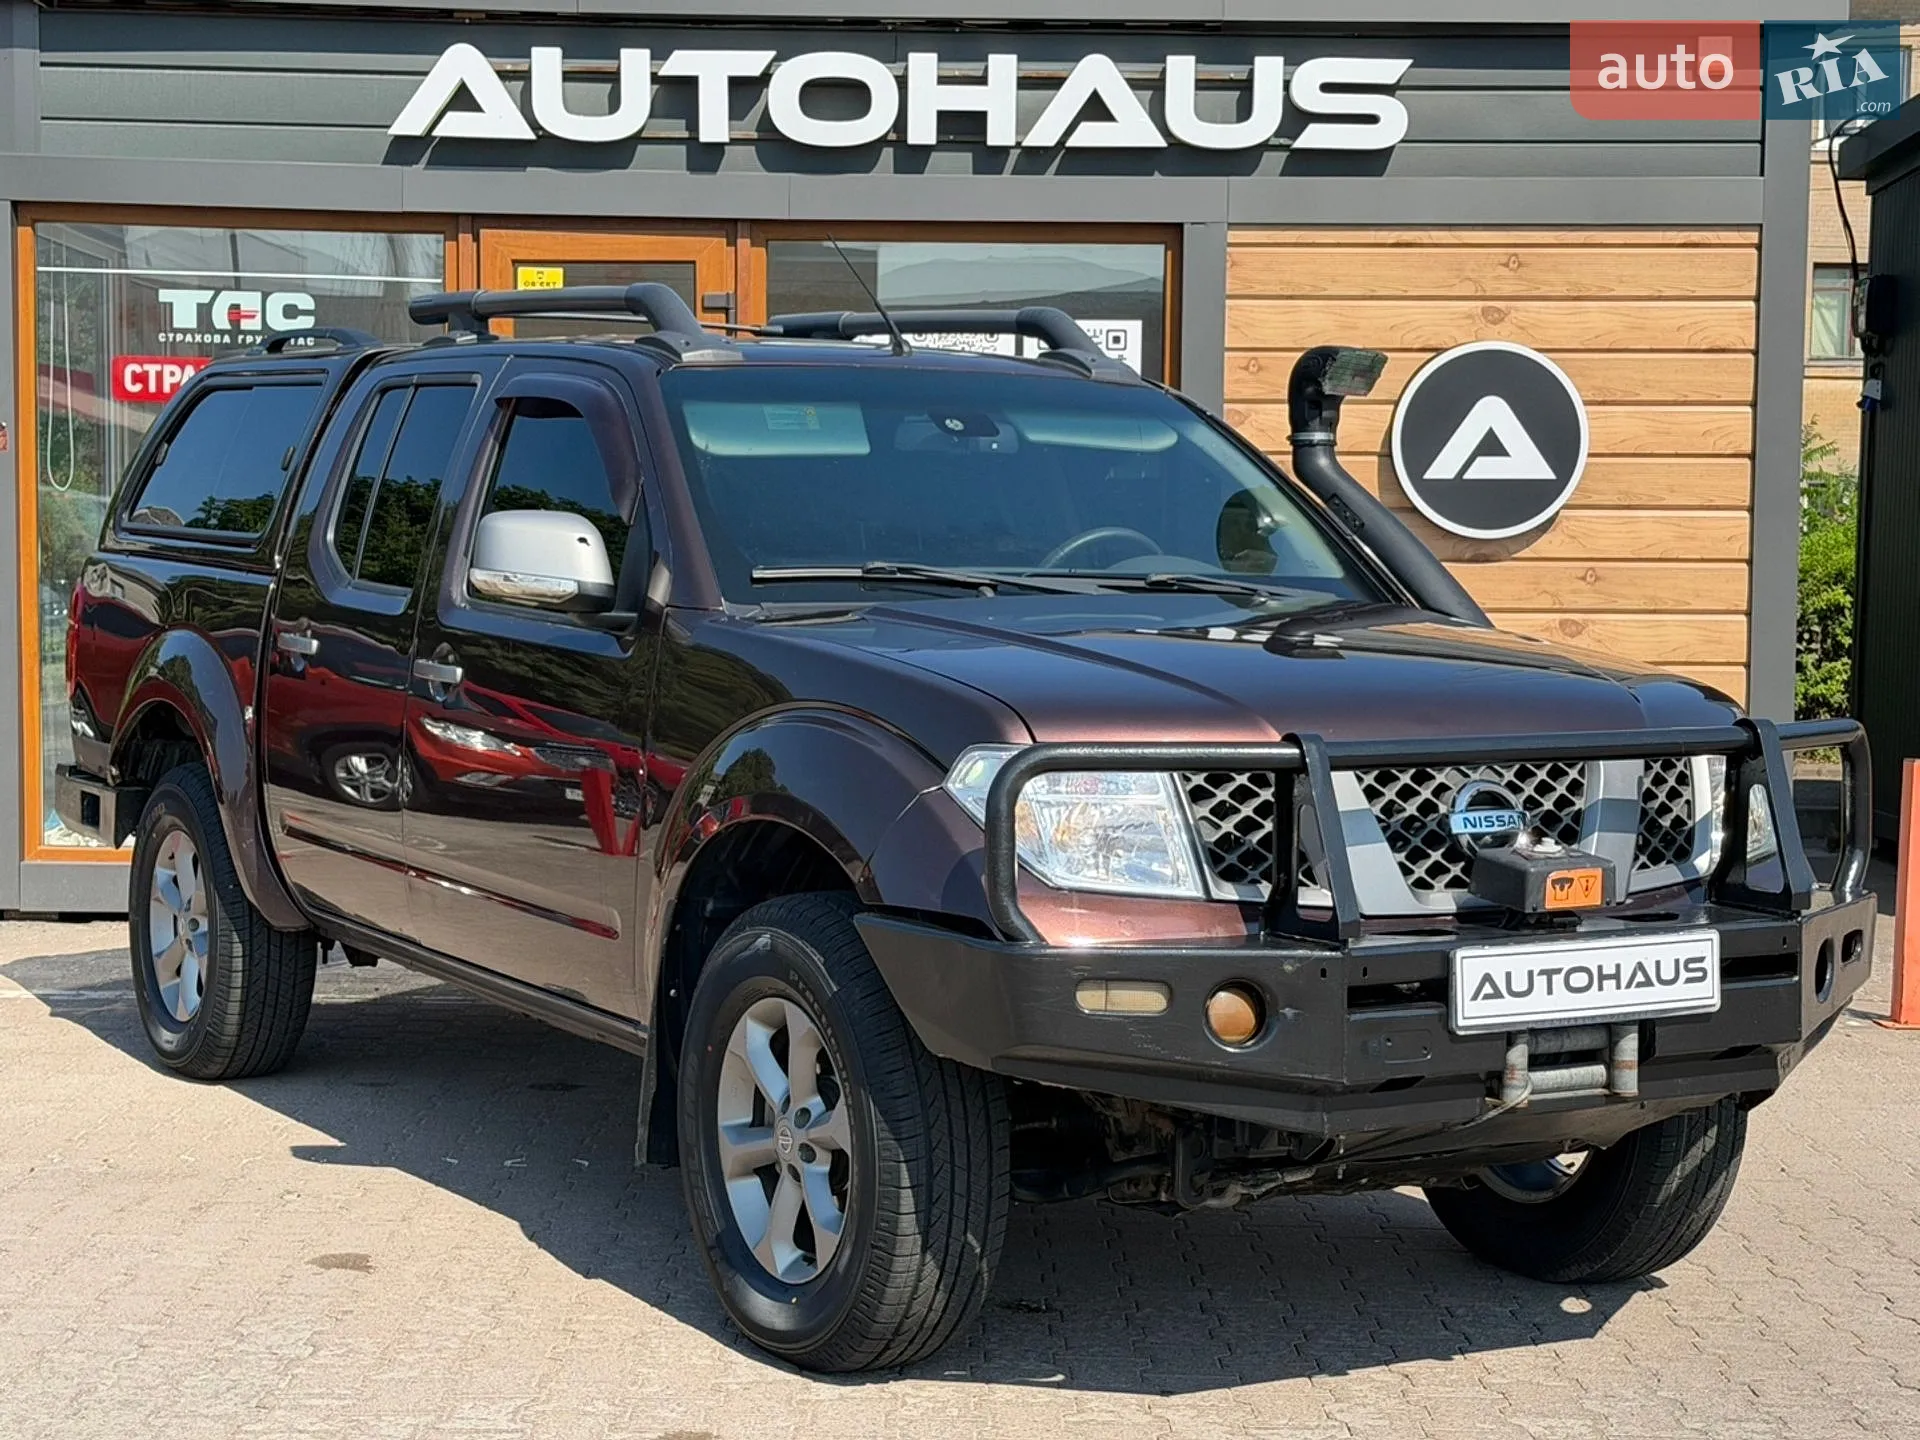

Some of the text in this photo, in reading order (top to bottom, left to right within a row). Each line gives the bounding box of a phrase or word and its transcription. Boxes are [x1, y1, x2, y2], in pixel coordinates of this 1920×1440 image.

[387, 42, 1414, 150] AUTOHAUS
[158, 288, 315, 331] ТАС
[158, 332, 231, 344] СТРАХОВА
[237, 333, 268, 345] ГРУ
[123, 363, 206, 394] СТРА
[1422, 394, 1557, 480] A
[1462, 814, 1527, 829] NISSAN
[1469, 956, 1708, 1002] AUTOHAUS
